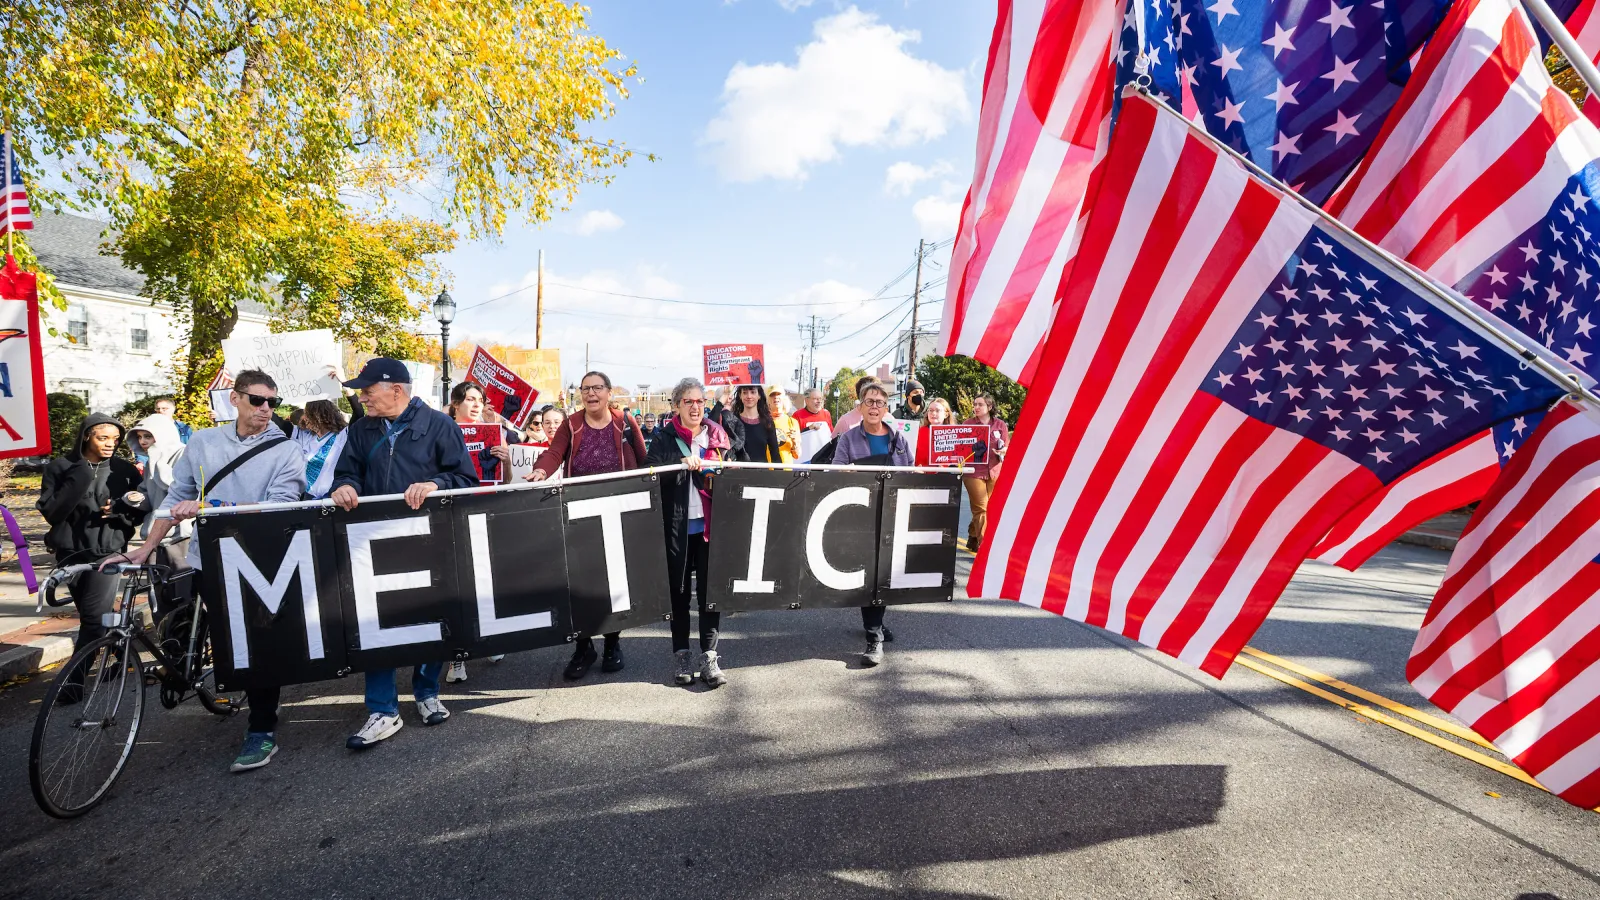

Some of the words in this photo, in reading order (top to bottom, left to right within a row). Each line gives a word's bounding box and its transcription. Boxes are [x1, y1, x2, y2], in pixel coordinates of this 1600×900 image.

[253, 335, 286, 350] STOP
[706, 346, 746, 355] EDUCATORS
[240, 347, 322, 369] KIDNAPPING
[478, 353, 514, 381] EDUCATORS
[219, 491, 652, 670] MELT
[732, 486, 952, 594] ICE
